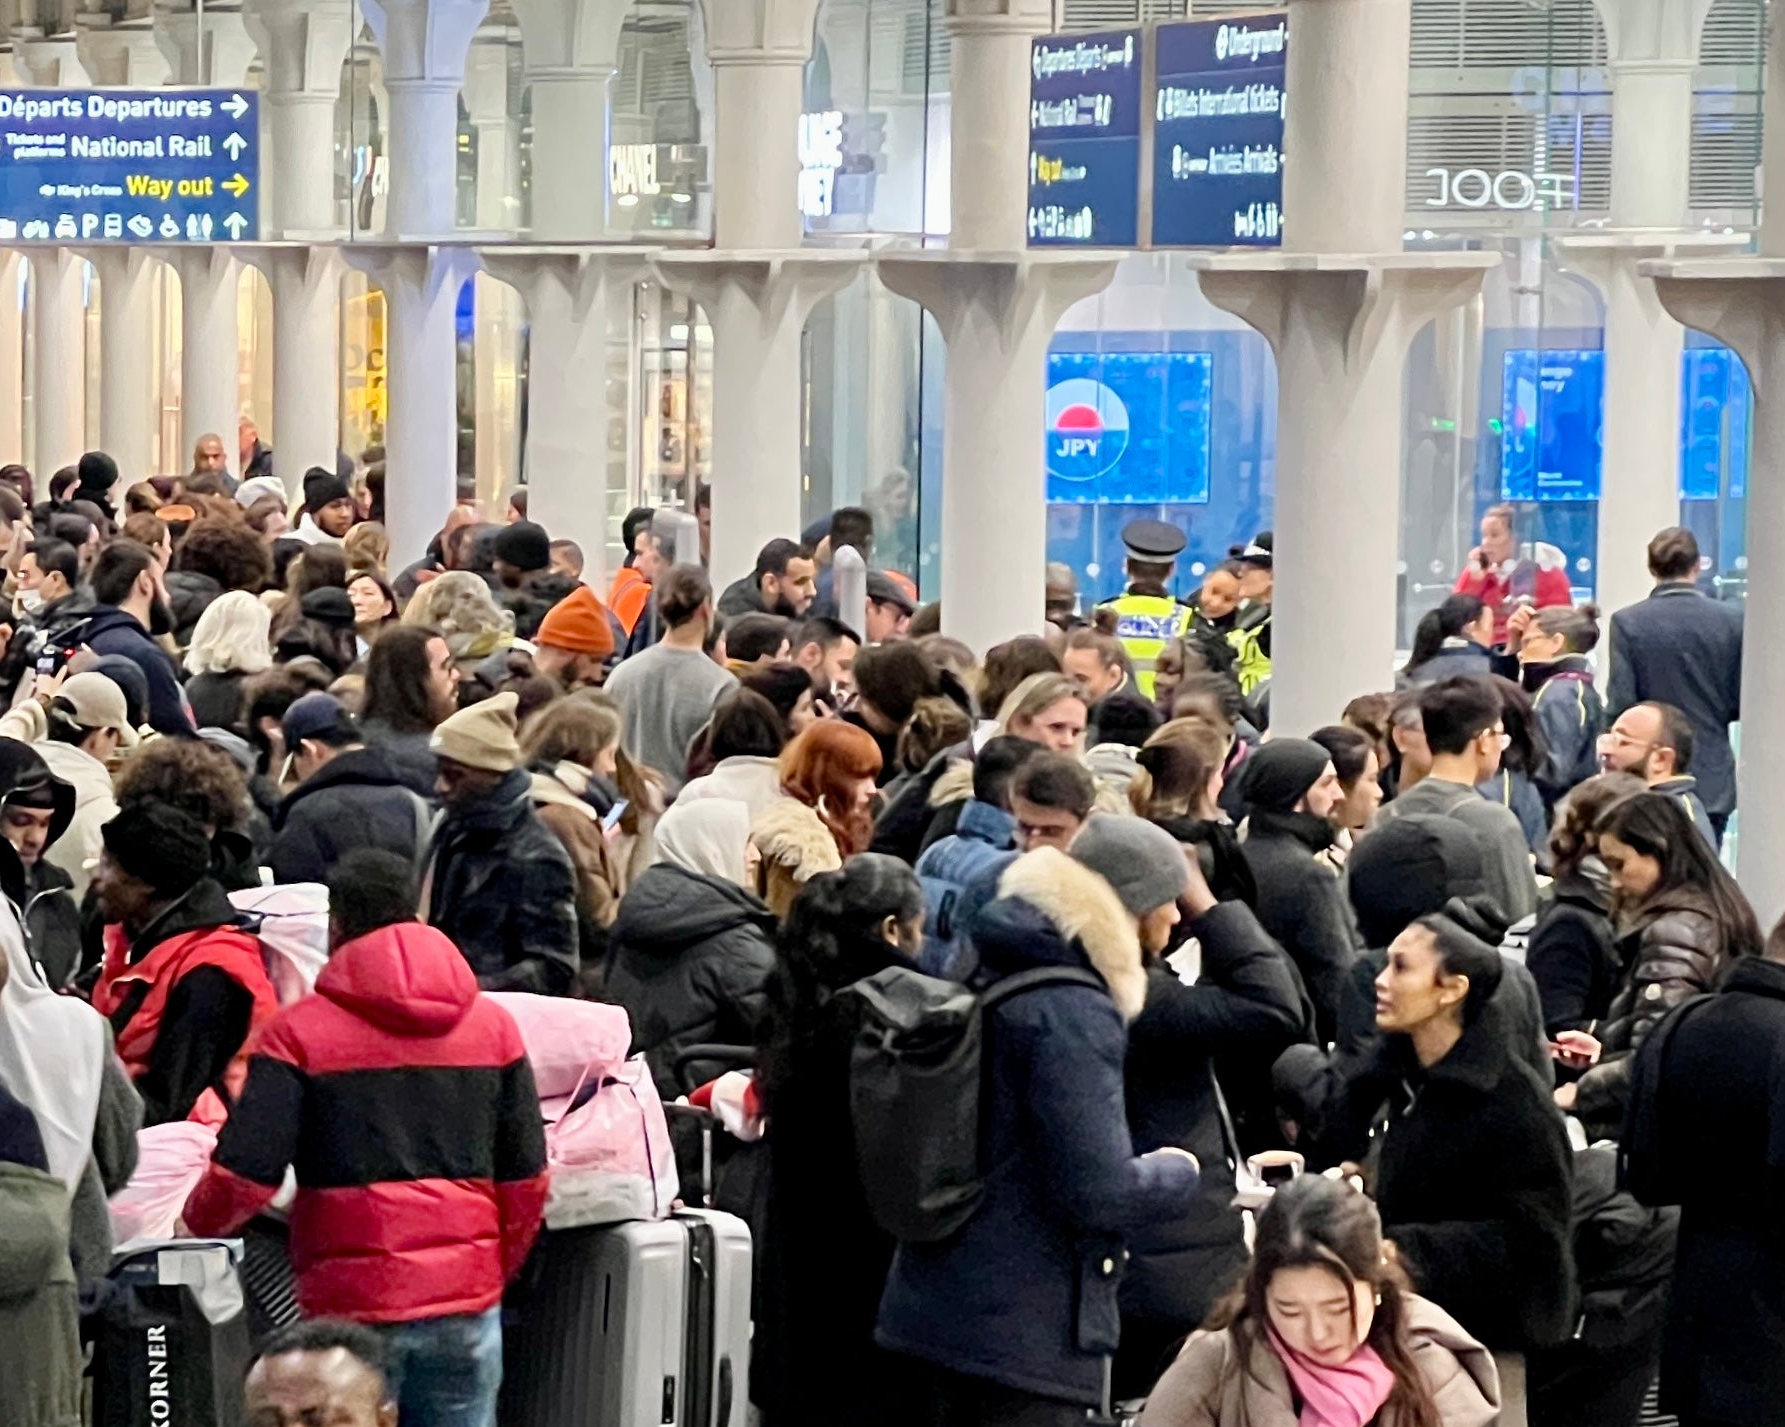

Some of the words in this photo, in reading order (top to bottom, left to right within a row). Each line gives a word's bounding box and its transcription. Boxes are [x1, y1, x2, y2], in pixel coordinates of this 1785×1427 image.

[88, 95, 213, 122] Departures
[71, 136, 164, 157] National
[169, 136, 213, 157] Rail
[610, 144, 660, 194] CHANEL
[126, 175, 174, 201] Way
[177, 177, 213, 196] out
[1055, 438, 1102, 457] JPY
